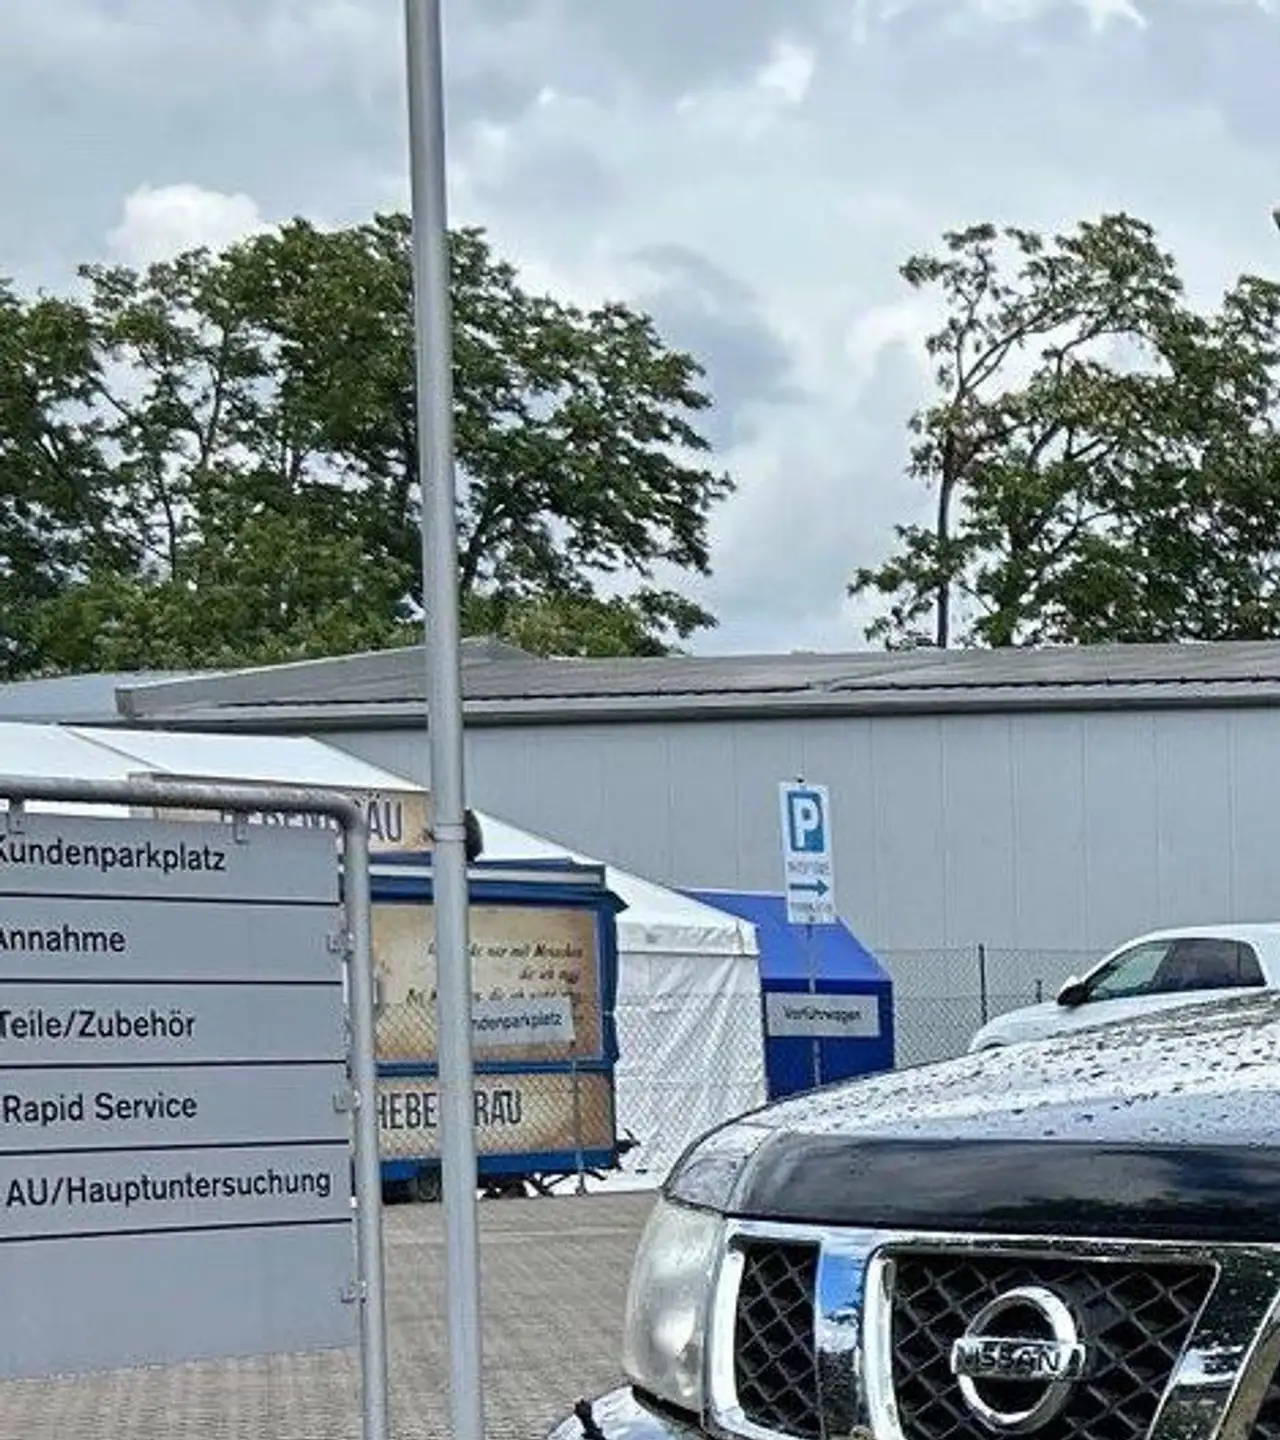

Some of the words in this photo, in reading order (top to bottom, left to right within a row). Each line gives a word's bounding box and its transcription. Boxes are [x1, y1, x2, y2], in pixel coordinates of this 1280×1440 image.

[0, 1009, 196, 1038] Teile/Zubehör
[3, 1093, 85, 1127] Rapid
[95, 1092, 198, 1121] Service
[6, 1169, 331, 1208] AU/Hauptuntersuchung
[956, 1342, 1064, 1374] NISSAN
